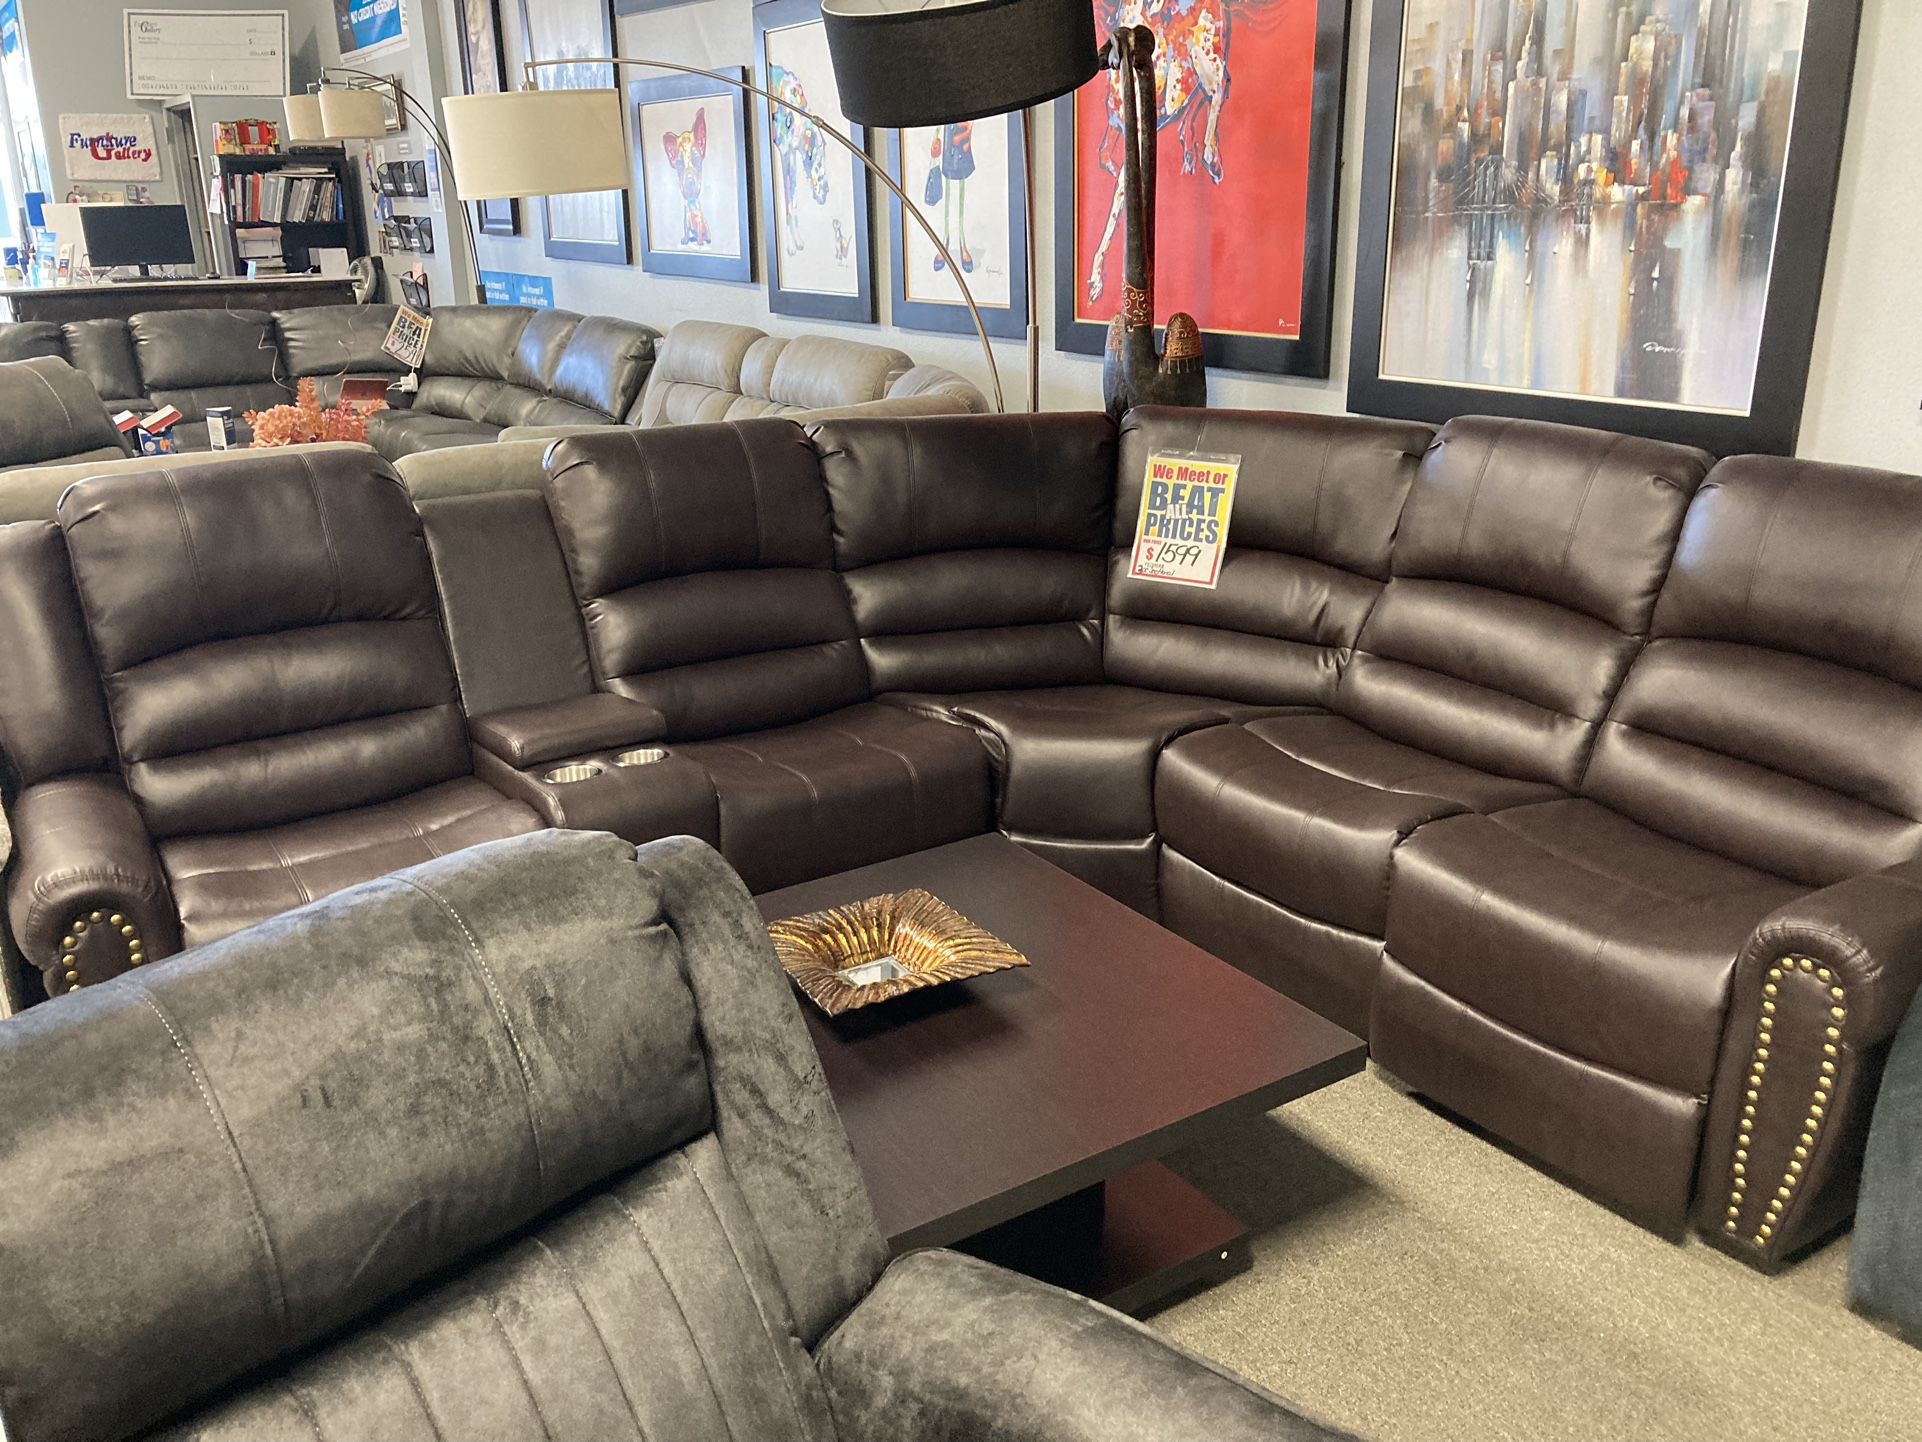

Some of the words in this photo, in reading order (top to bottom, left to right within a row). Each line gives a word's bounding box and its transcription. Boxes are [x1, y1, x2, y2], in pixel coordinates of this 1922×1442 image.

[68, 132, 137, 149] Furniture
[89, 135, 152, 162] Gallery
[1152, 463, 1174, 480] We
[1176, 466, 1211, 483] Meet
[1213, 470, 1229, 485] or
[1147, 480, 1226, 518] BEAT
[1166, 503, 1189, 519] ALL
[1143, 511, 1220, 545] PRICES
